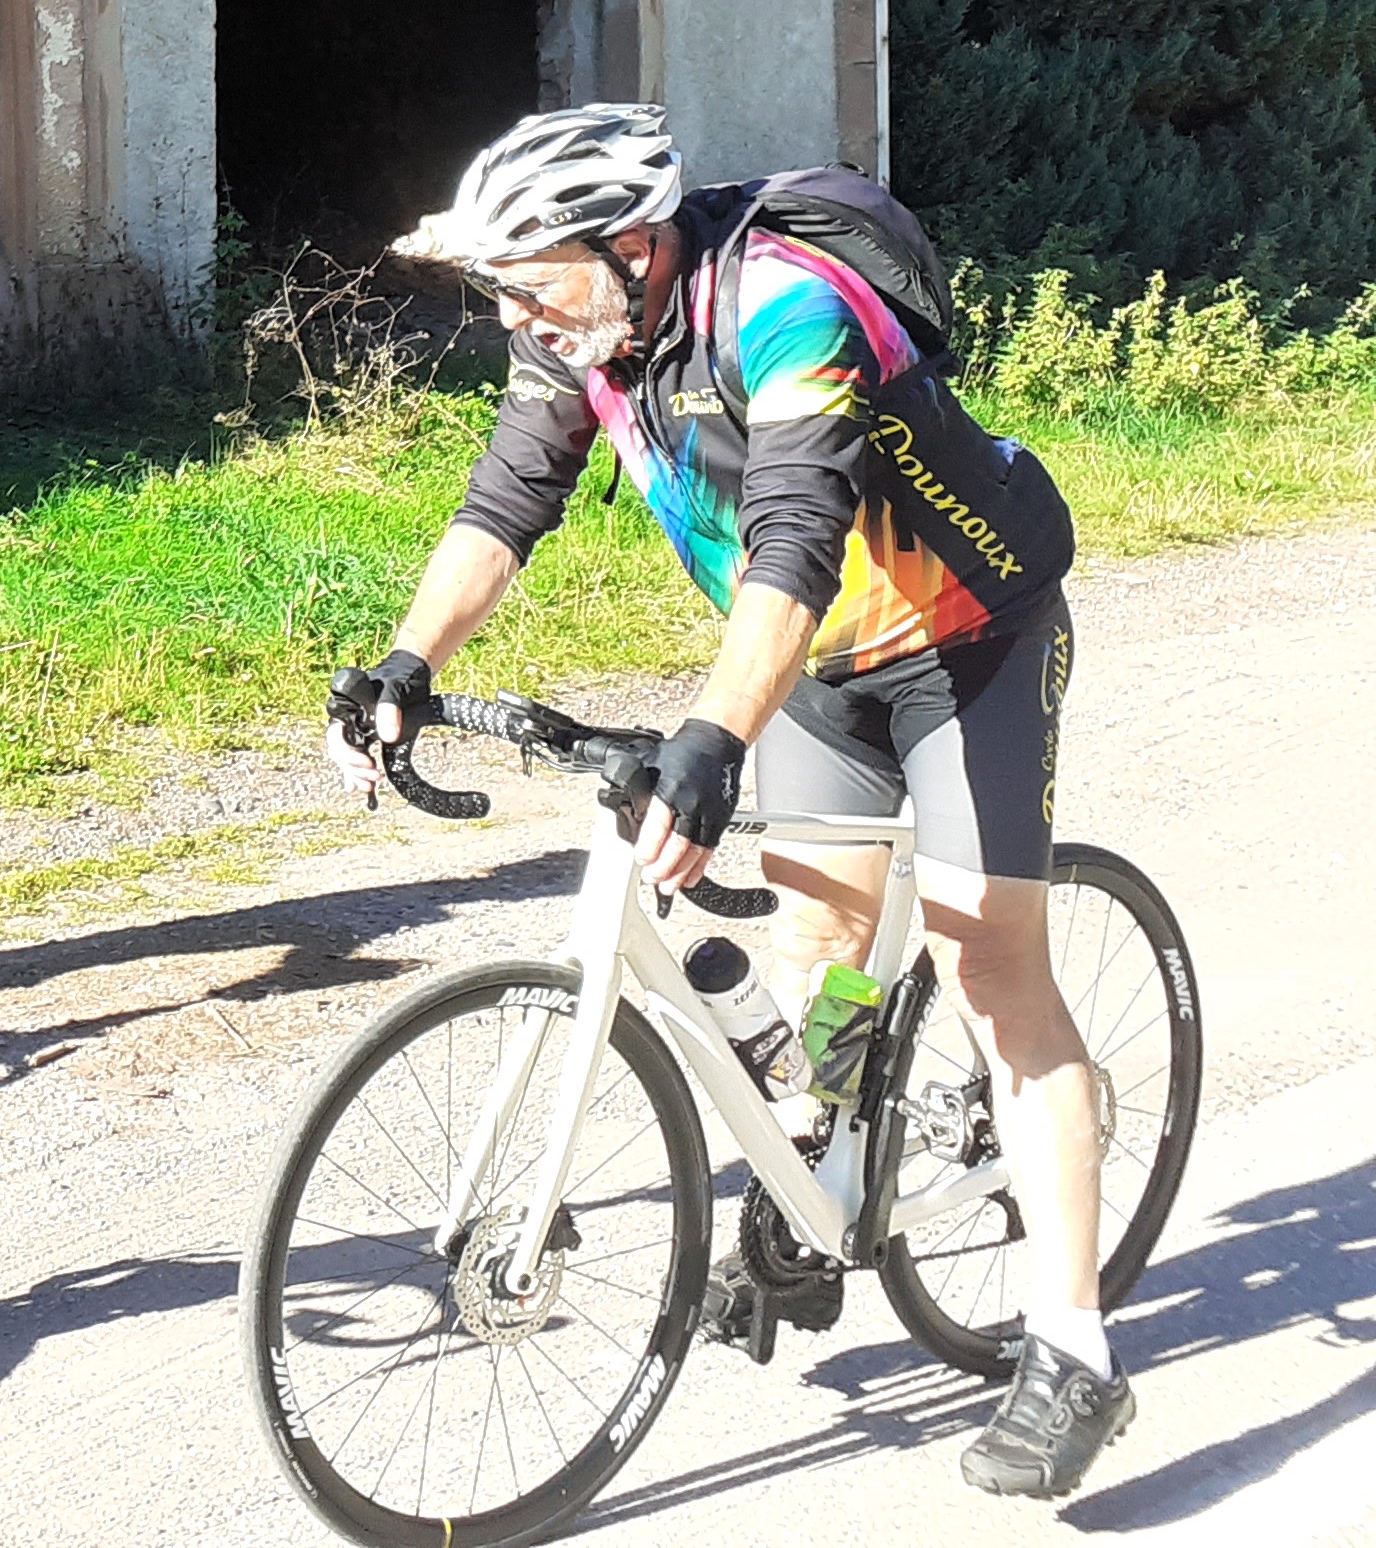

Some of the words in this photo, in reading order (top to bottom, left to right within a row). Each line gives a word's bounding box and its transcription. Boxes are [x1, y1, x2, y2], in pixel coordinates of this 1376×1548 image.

[868, 414, 1023, 580] Dounoux
[496, 987, 580, 1012] MAVIC
[1161, 947, 1195, 1021] MAVIC
[270, 1346, 311, 1439] MAVIC
[609, 1352, 667, 1454] MAVIC
